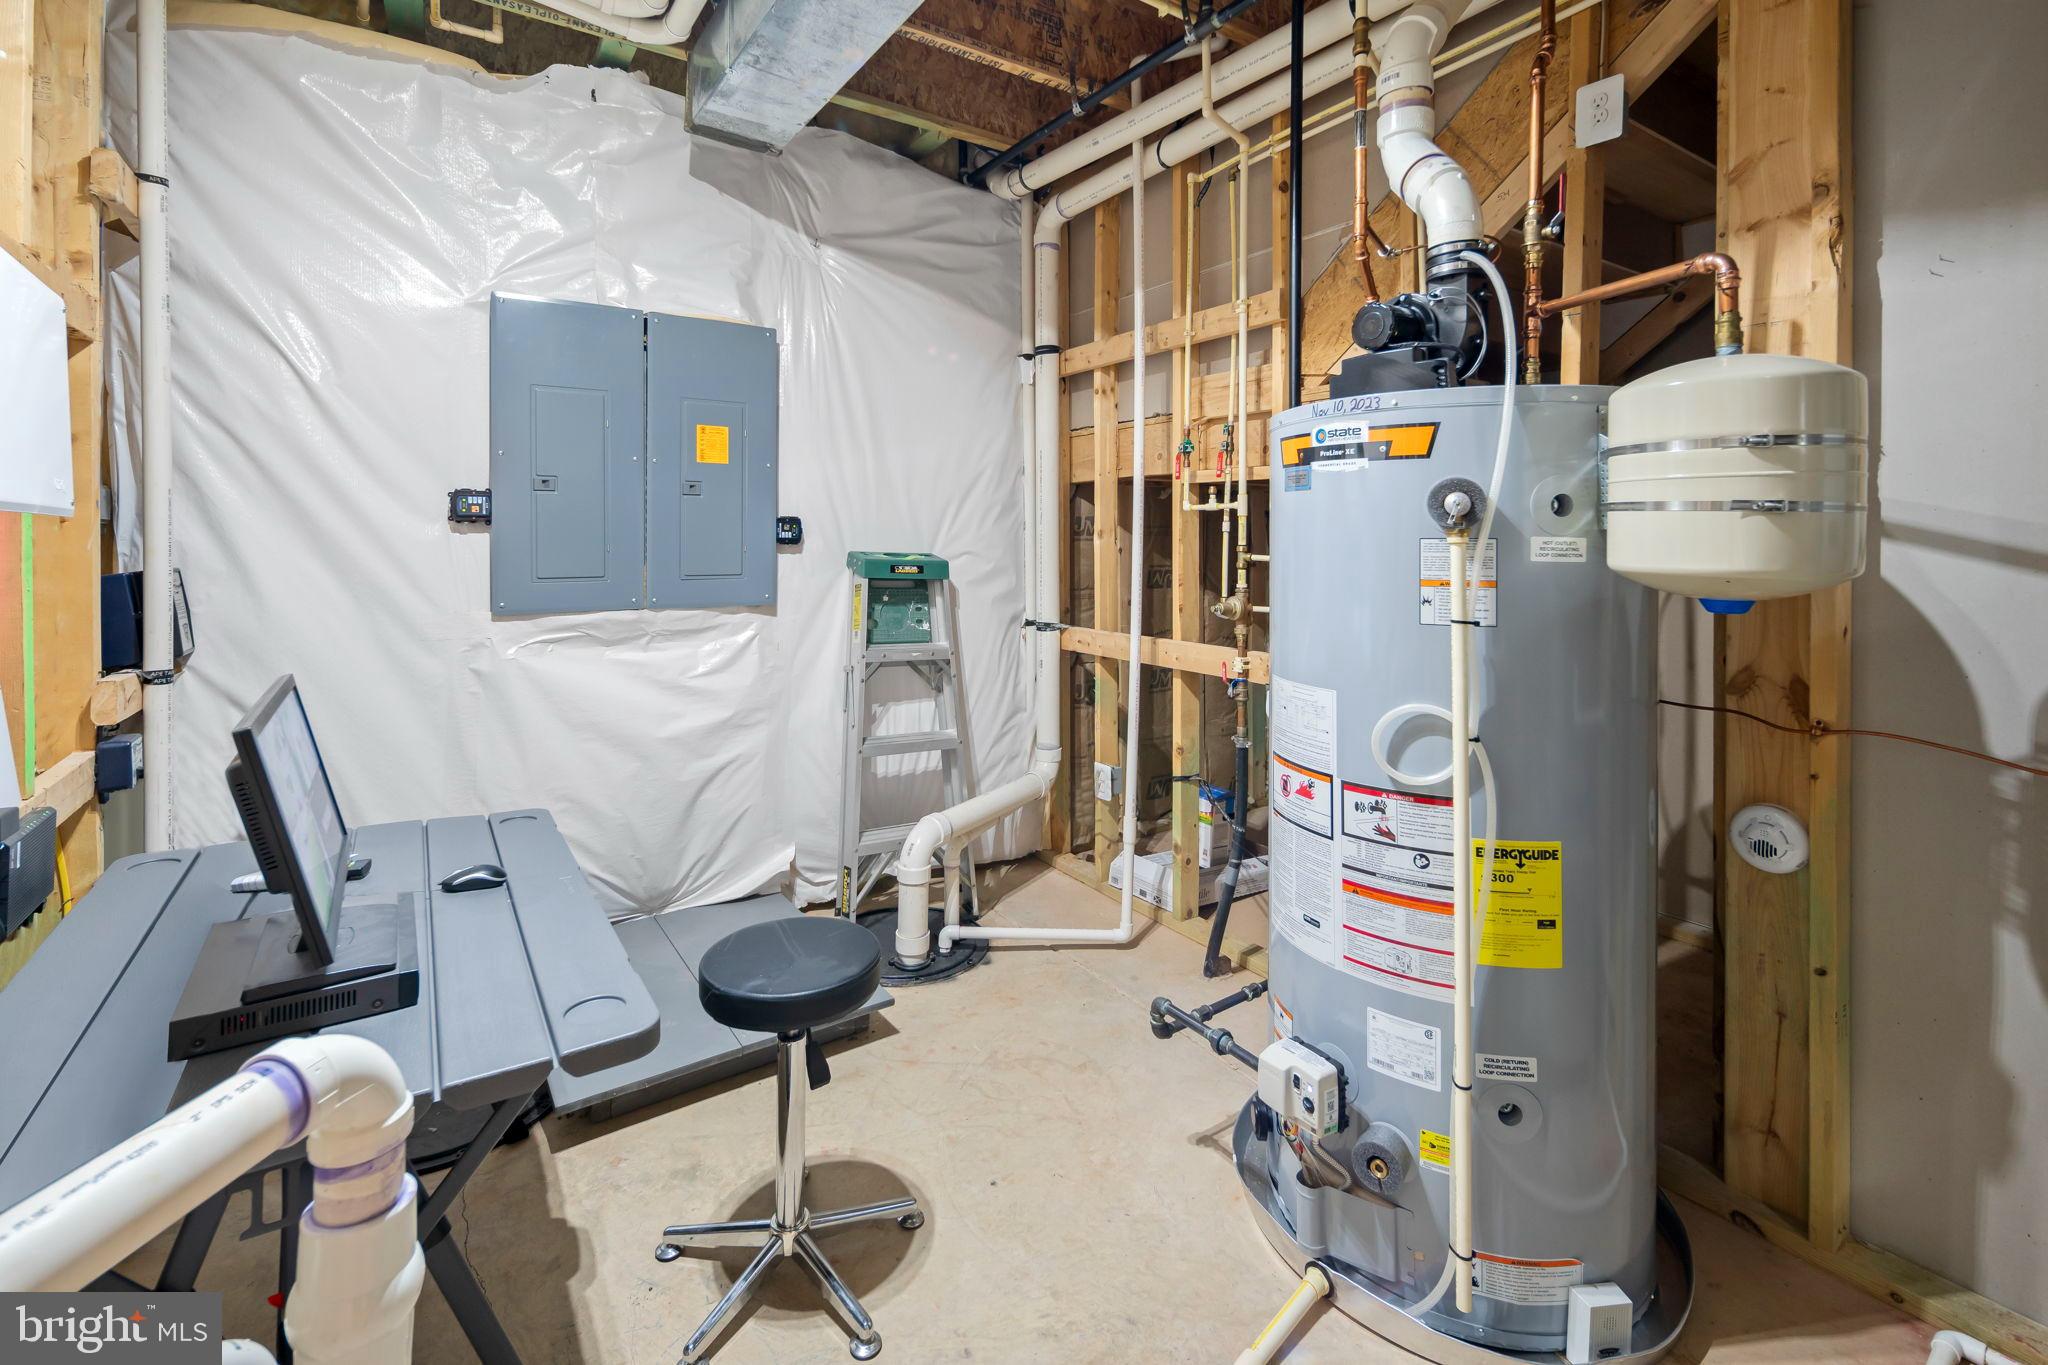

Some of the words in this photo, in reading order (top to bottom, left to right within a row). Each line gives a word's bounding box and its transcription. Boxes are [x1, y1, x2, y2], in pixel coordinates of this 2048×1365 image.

[1312, 404, 1328, 418] Nov
[1333, 399, 1347, 416] 10,
[1350, 396, 1381, 412] 2023
[1327, 427, 1362, 438] state
[1388, 793, 1414, 802] DANGER
[1475, 847, 1559, 861] EERGYGUIDE
[1483, 1063, 1530, 1072] RECIRCULATING
